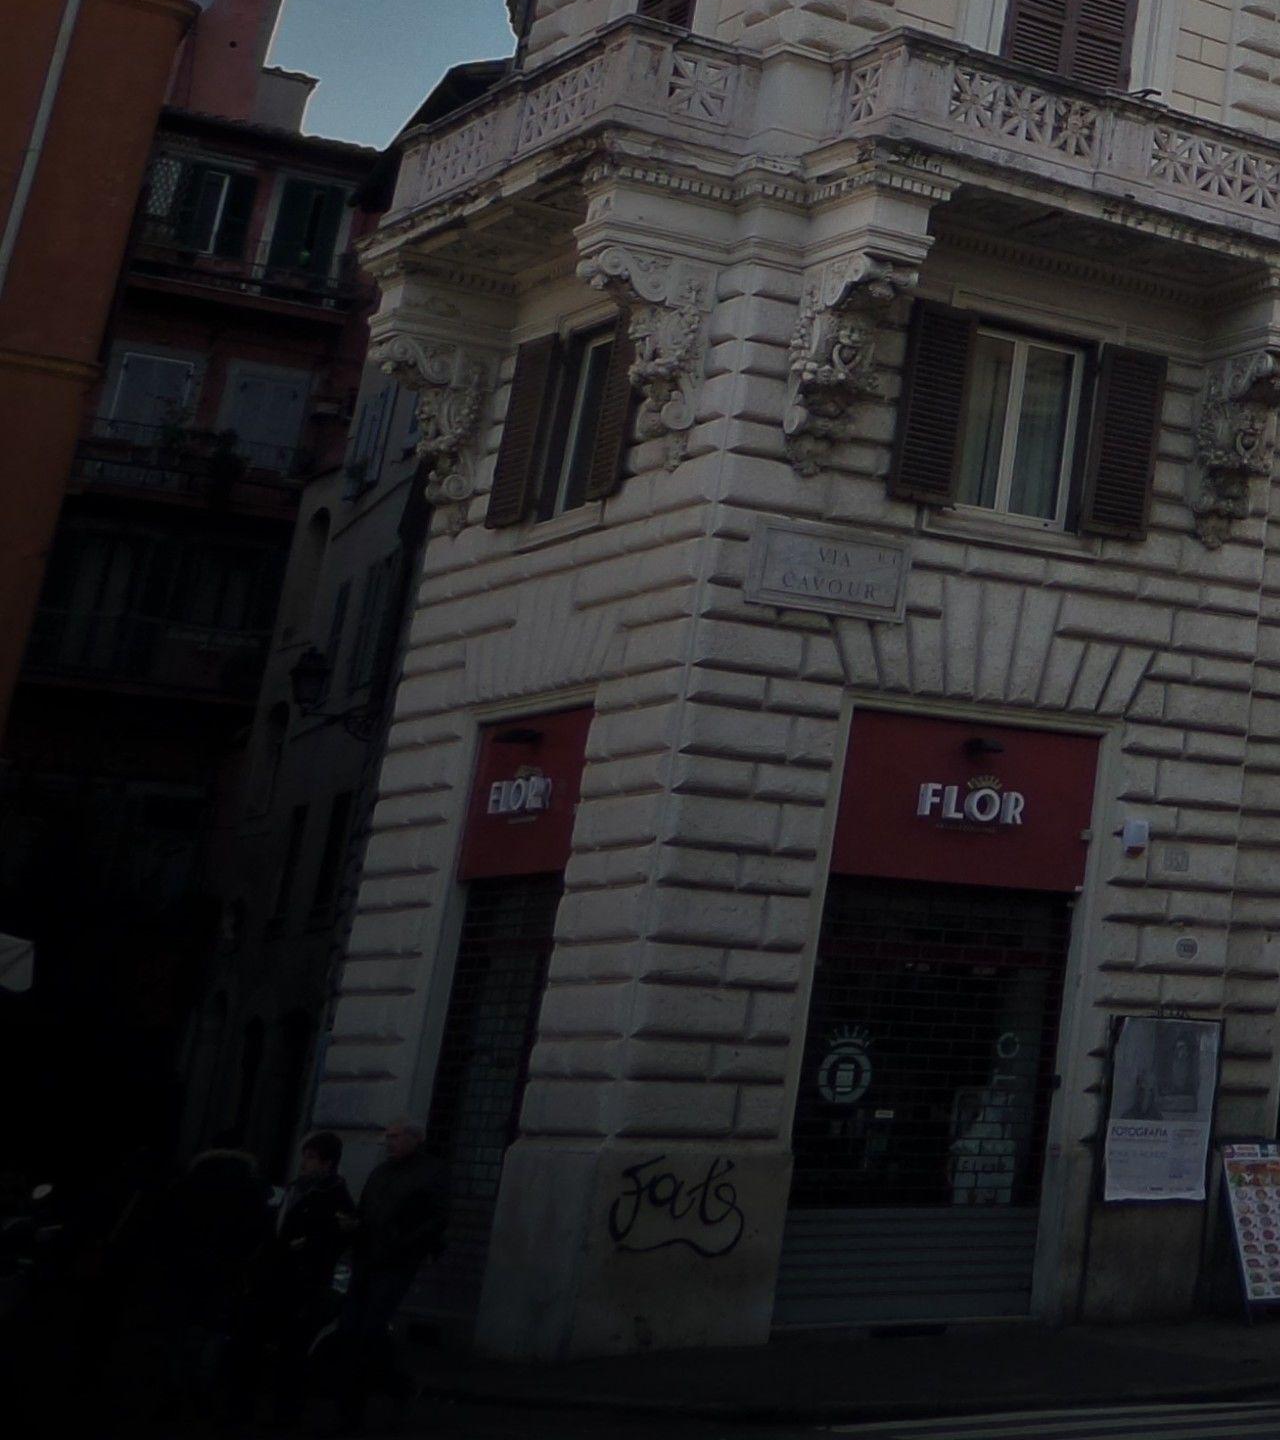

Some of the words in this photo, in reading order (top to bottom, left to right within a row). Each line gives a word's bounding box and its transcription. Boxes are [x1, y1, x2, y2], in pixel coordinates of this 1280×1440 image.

[819, 546, 851, 568] VIA
[782, 570, 877, 601] CAVOUR
[917, 782, 1025, 825] FLOR
[1111, 1126, 1168, 1137] FOTOGRAFIA
